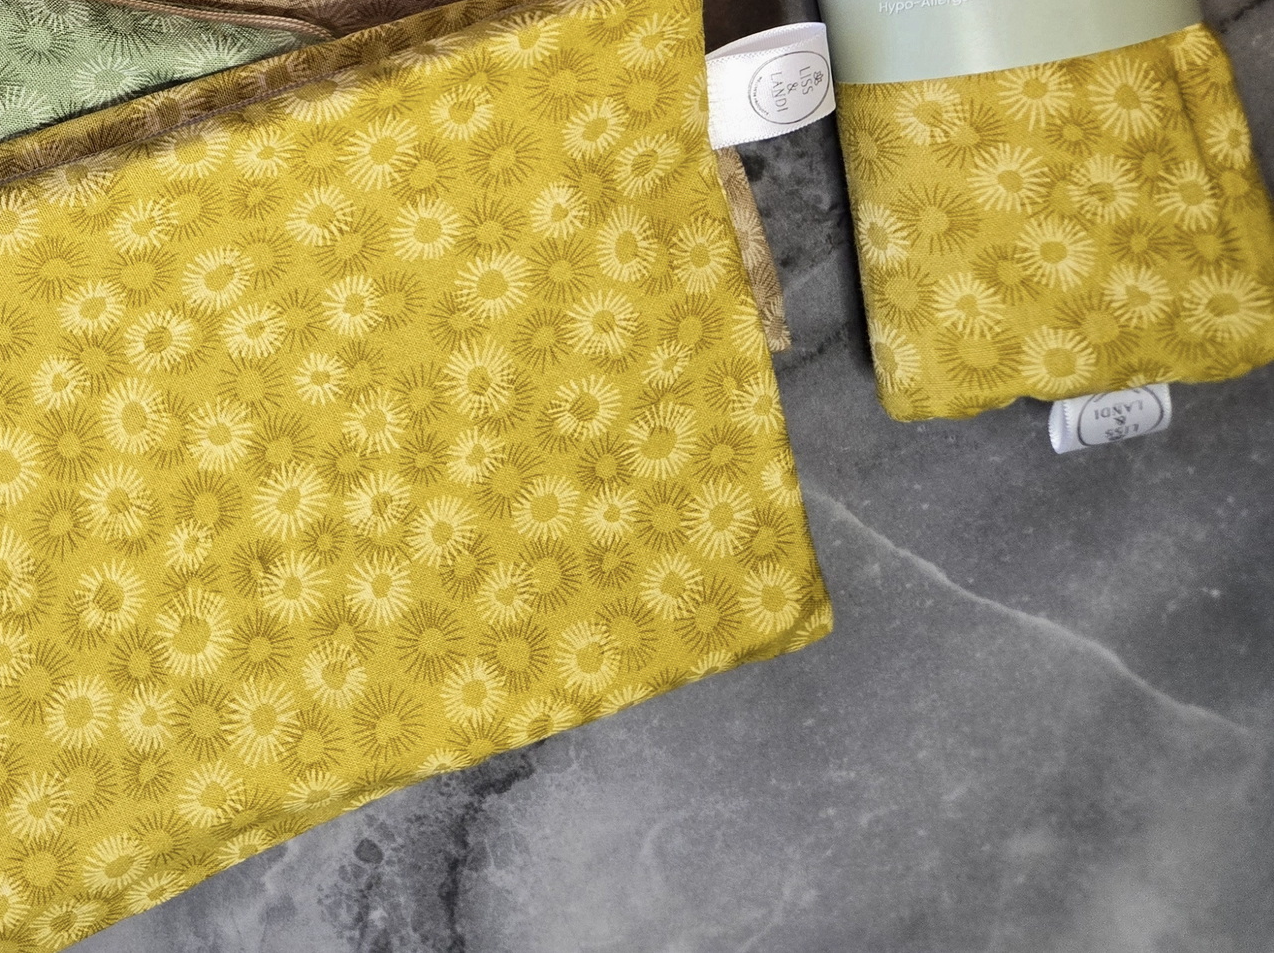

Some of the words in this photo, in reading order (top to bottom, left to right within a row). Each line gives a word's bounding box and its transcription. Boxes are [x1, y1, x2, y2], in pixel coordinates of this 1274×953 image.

[786, 82, 799, 94] &
[799, 65, 814, 95] LISS
[770, 71, 789, 112] LANDI
[1094, 399, 1143, 420] LANDI
[1105, 423, 1139, 438] LISS
